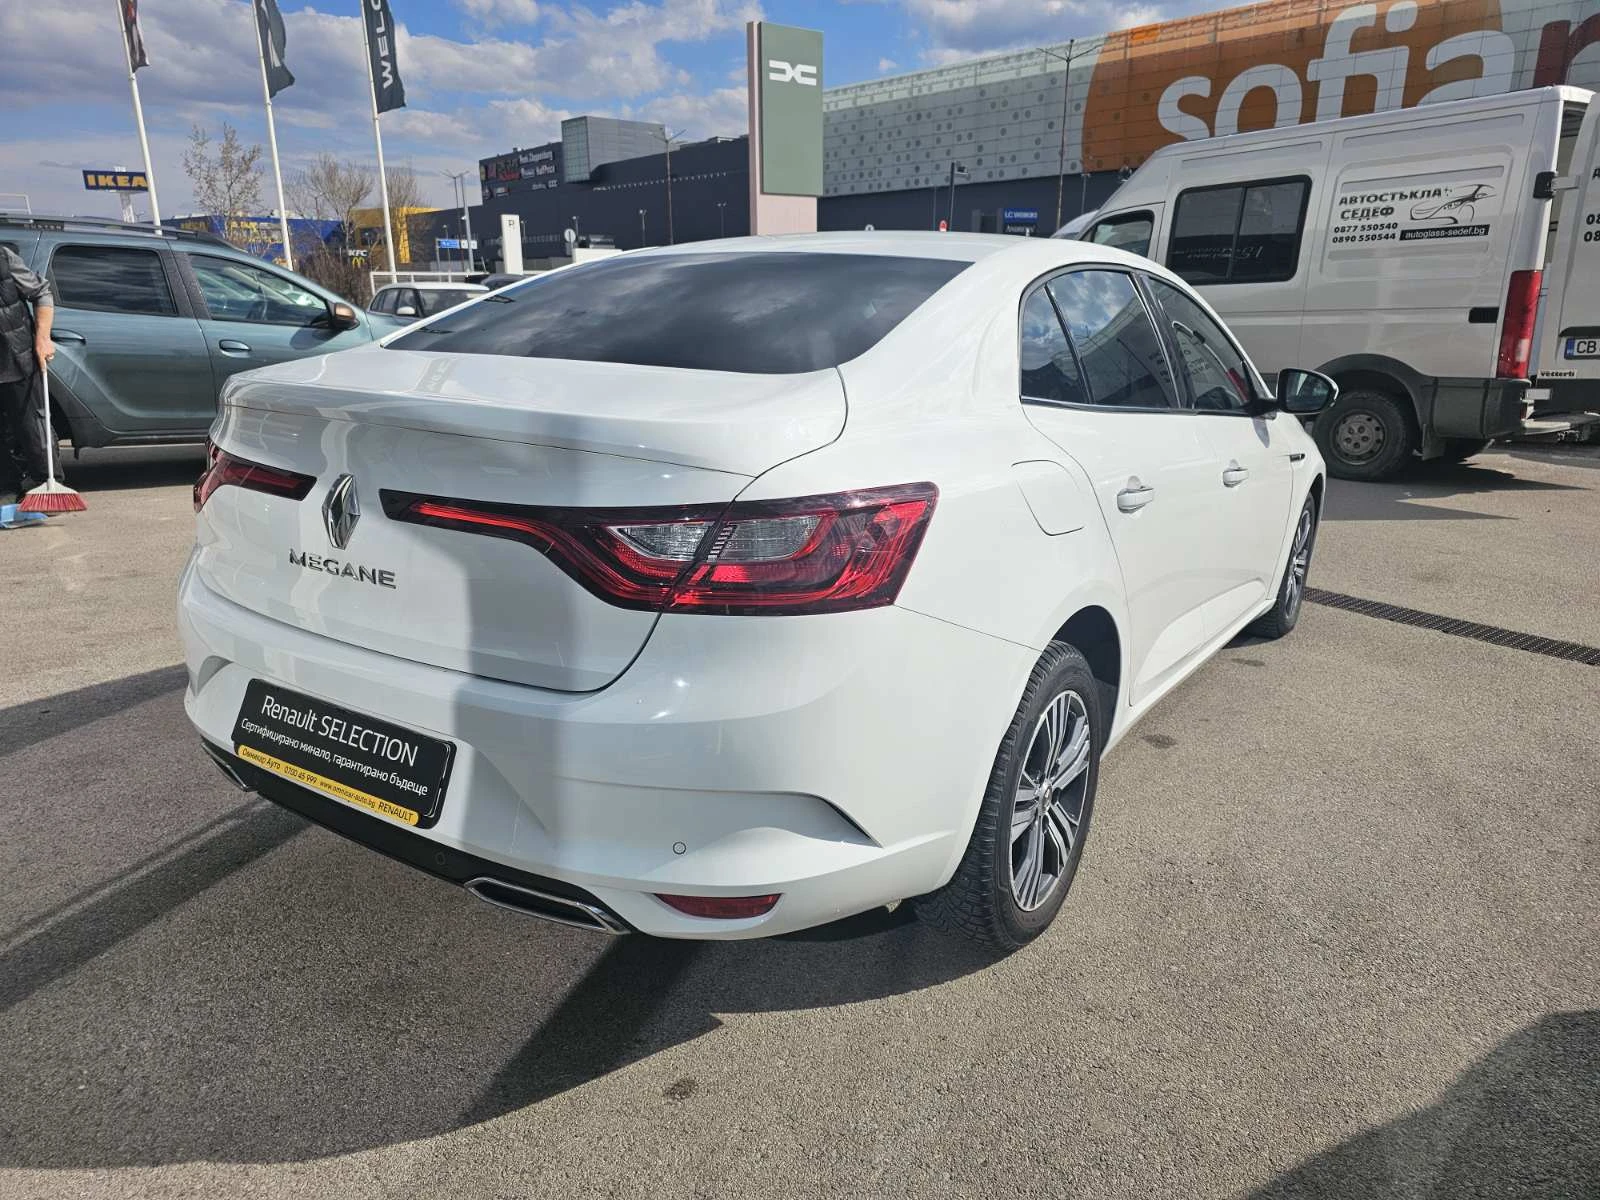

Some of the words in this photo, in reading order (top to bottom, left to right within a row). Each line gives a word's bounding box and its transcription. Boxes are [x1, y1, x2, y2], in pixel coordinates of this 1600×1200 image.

[87, 174, 148, 187] IKEA
[1339, 187, 1442, 206] АВТОСТЪКЛА
[1340, 206, 1395, 221] СЕДЕФ
[1334, 225, 1358, 234] 0877
[1360, 222, 1398, 231] 550540
[1405, 226, 1485, 240] autoglass-sedef.bg
[1332, 234, 1356, 244] 0890
[1358, 232, 1396, 242] 550544
[348, 249, 368, 257] KFC
[289, 548, 396, 589] MEGANE
[261, 695, 318, 732] Renault
[318, 715, 419, 767] SELECTION
[241, 718, 299, 749] Сертифицирано
[299, 742, 332, 763] минало,
[332, 754, 389, 781] гарантирано
[389, 772, 428, 796] бъдеще
[378, 801, 414, 823] RENAULT
